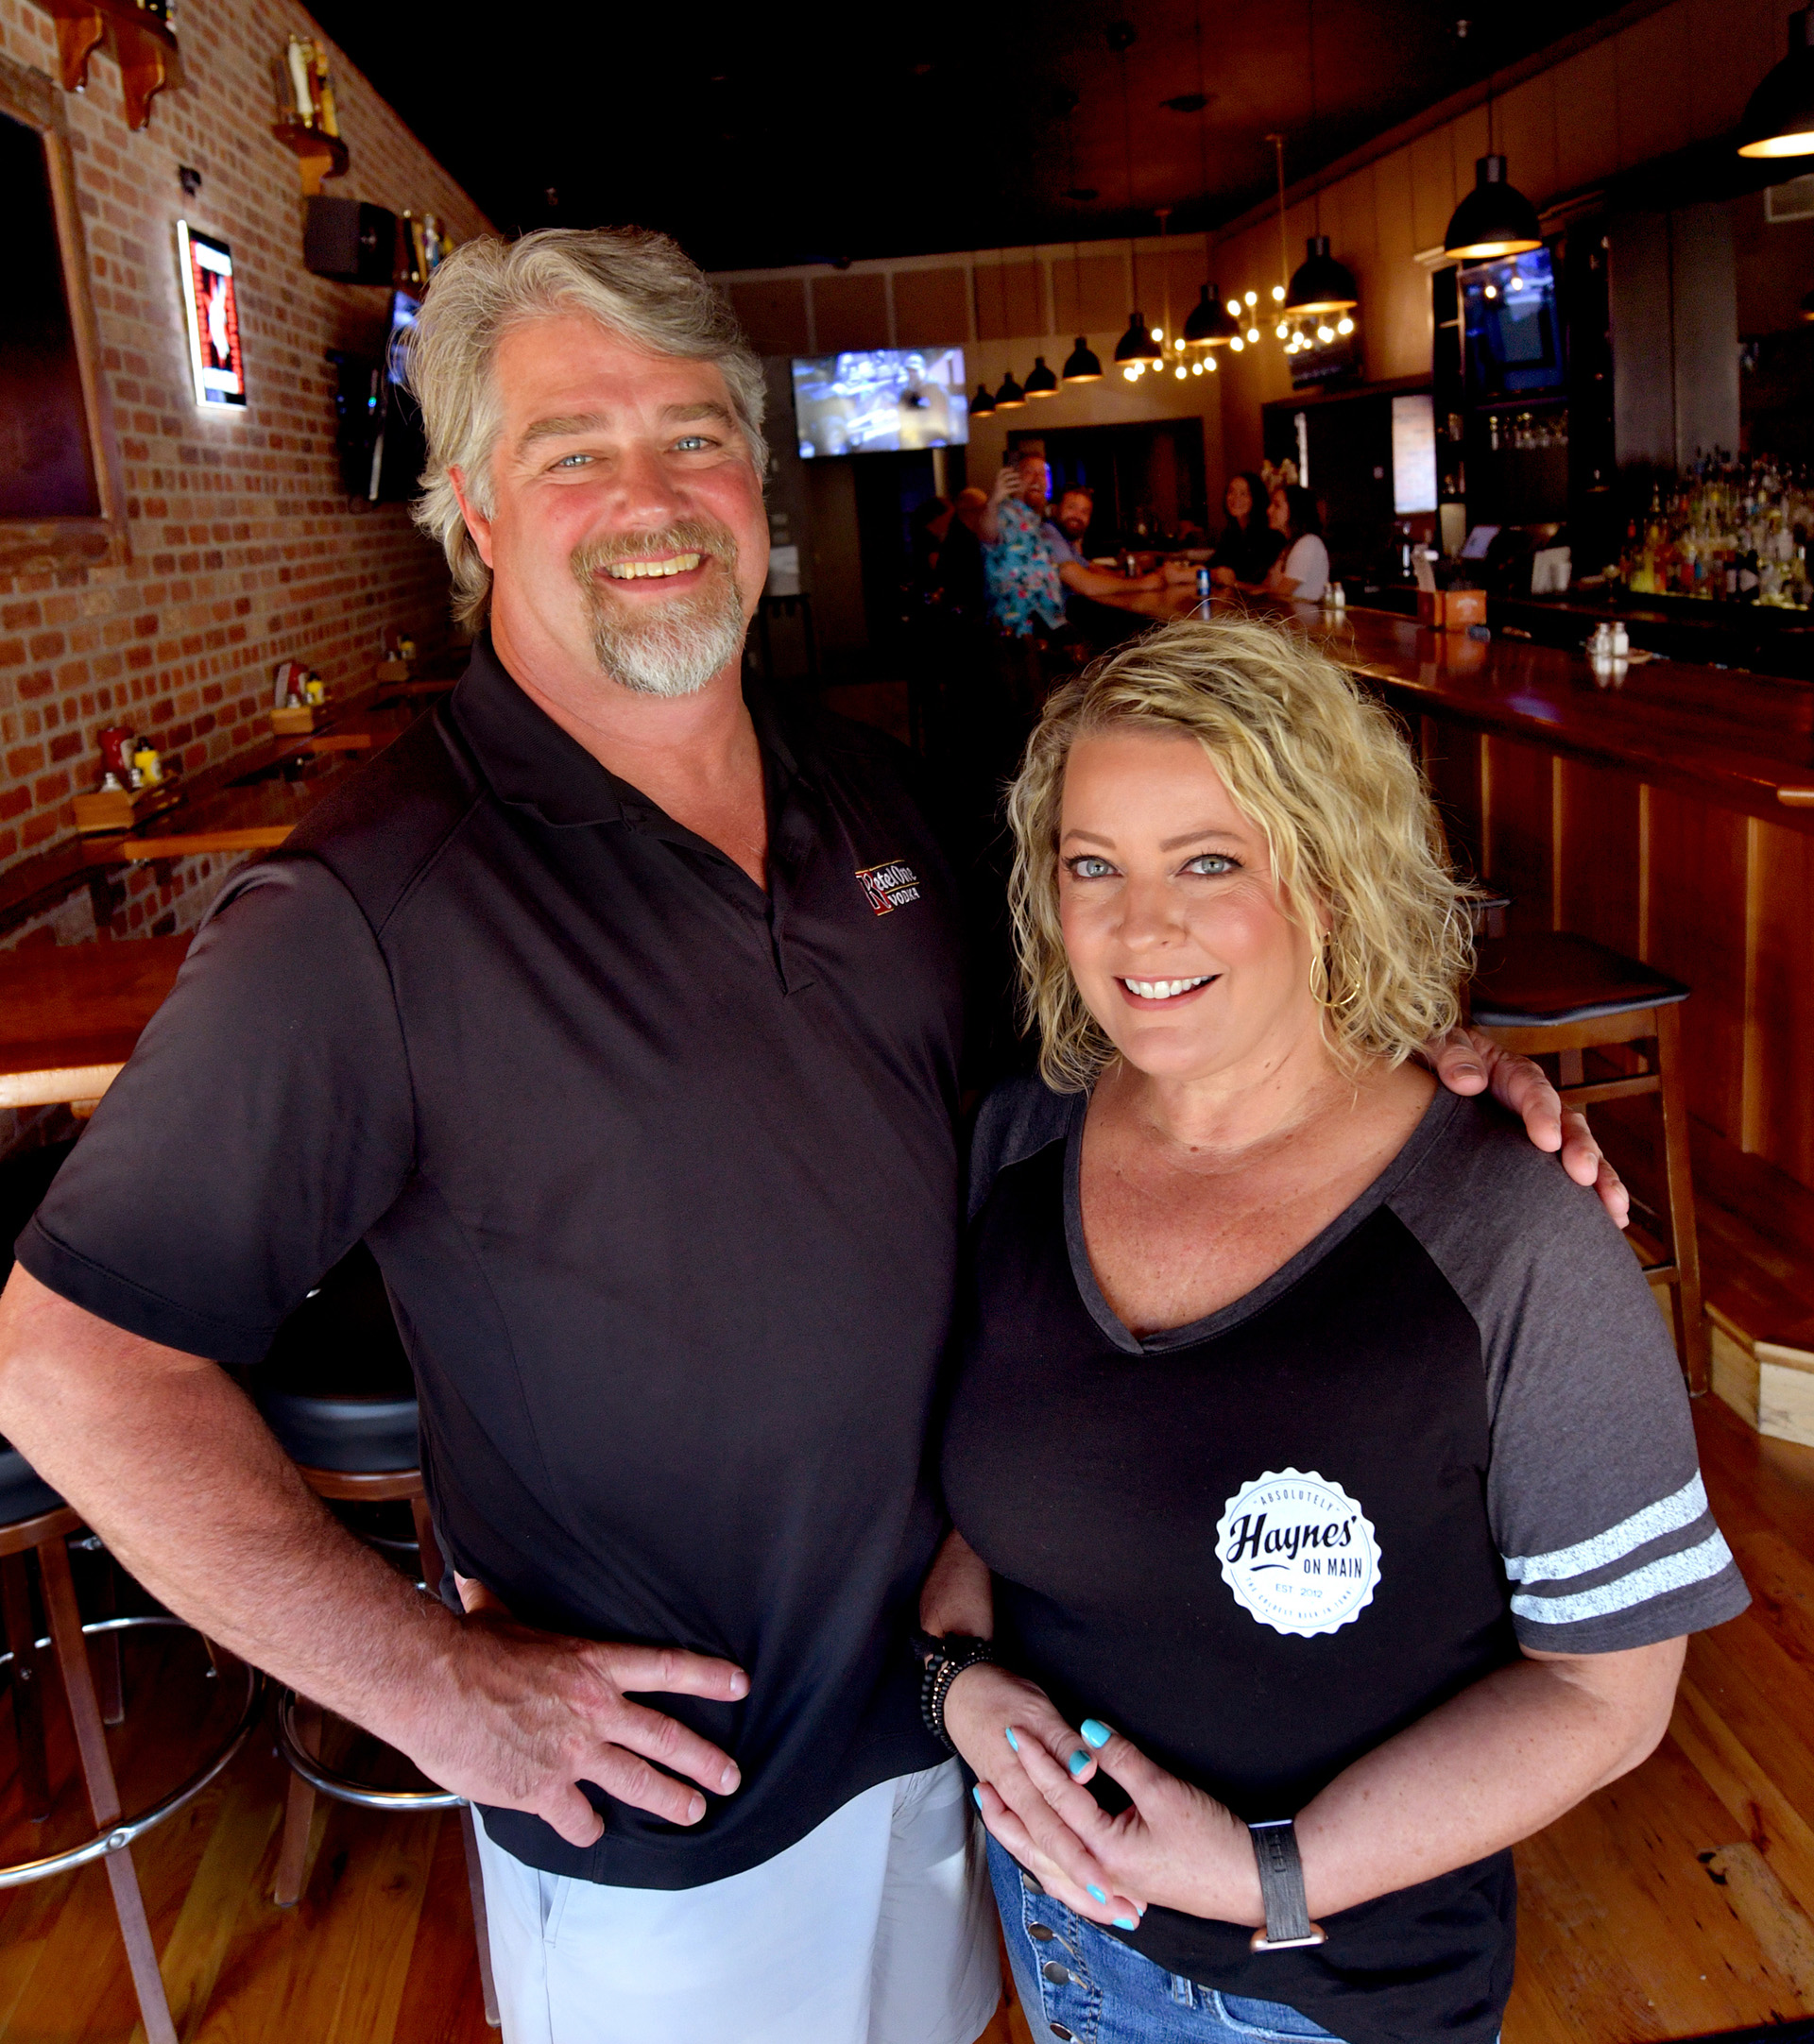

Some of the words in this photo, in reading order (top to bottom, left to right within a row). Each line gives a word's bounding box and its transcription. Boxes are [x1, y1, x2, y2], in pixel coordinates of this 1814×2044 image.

[887, 887, 920, 907] VODKA
[1260, 1489, 1333, 1511] ABSOLUTELY
[1226, 1512, 1357, 1563] Haynes'
[1303, 1559, 1321, 1575] ON
[1327, 1558, 1362, 1578] MAIN
[1275, 1583, 1293, 1593] EST
[1300, 1588, 1323, 1598] 2012
